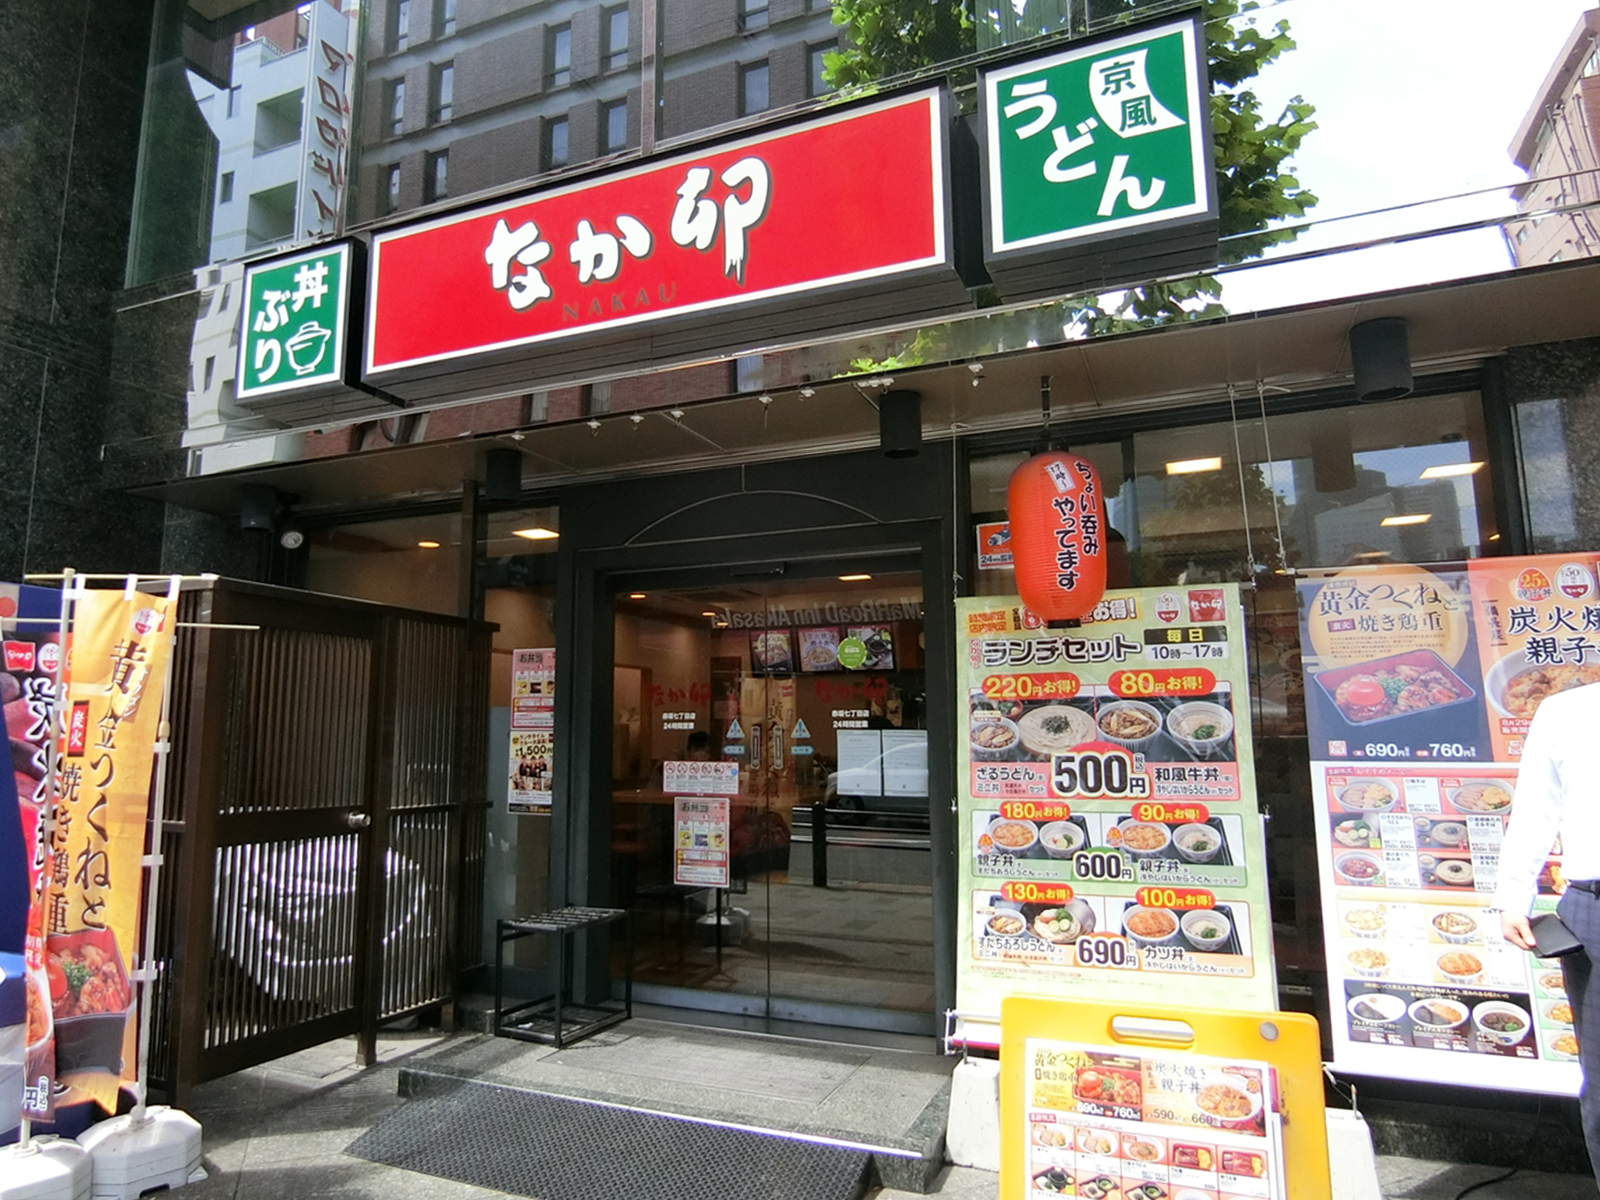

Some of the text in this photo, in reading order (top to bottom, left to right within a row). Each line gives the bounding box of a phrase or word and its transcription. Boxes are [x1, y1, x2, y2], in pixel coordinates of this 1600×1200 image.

[1099, 61, 1157, 131] 京風
[1004, 78, 1166, 217] うどん
[484, 156, 772, 311] なか卯
[562, 282, 678, 322] NAKAU
[1074, 460, 1100, 557] ちょい呑み
[1052, 497, 1079, 591] やってます
[1190, 598, 1223, 611] なか卯
[1319, 581, 1459, 617] 黄金つくねと
[1166, 628, 1204, 643] 毎日
[1357, 611, 1444, 633] 焼き鶏重
[983, 633, 1142, 667] ランチセット
[1525, 636, 1600, 664] 親子
[71, 709, 85, 748] 炭火
[977, 767, 1036, 781] ざるうどん
[1154, 767, 1220, 782] 和風牛丼
[977, 853, 1014, 867] 親子丼
[1139, 859, 1180, 872] 親子丼
[1144, 946, 1185, 961] カツ丼
[1161, 1078, 1202, 1095] 親子丼
